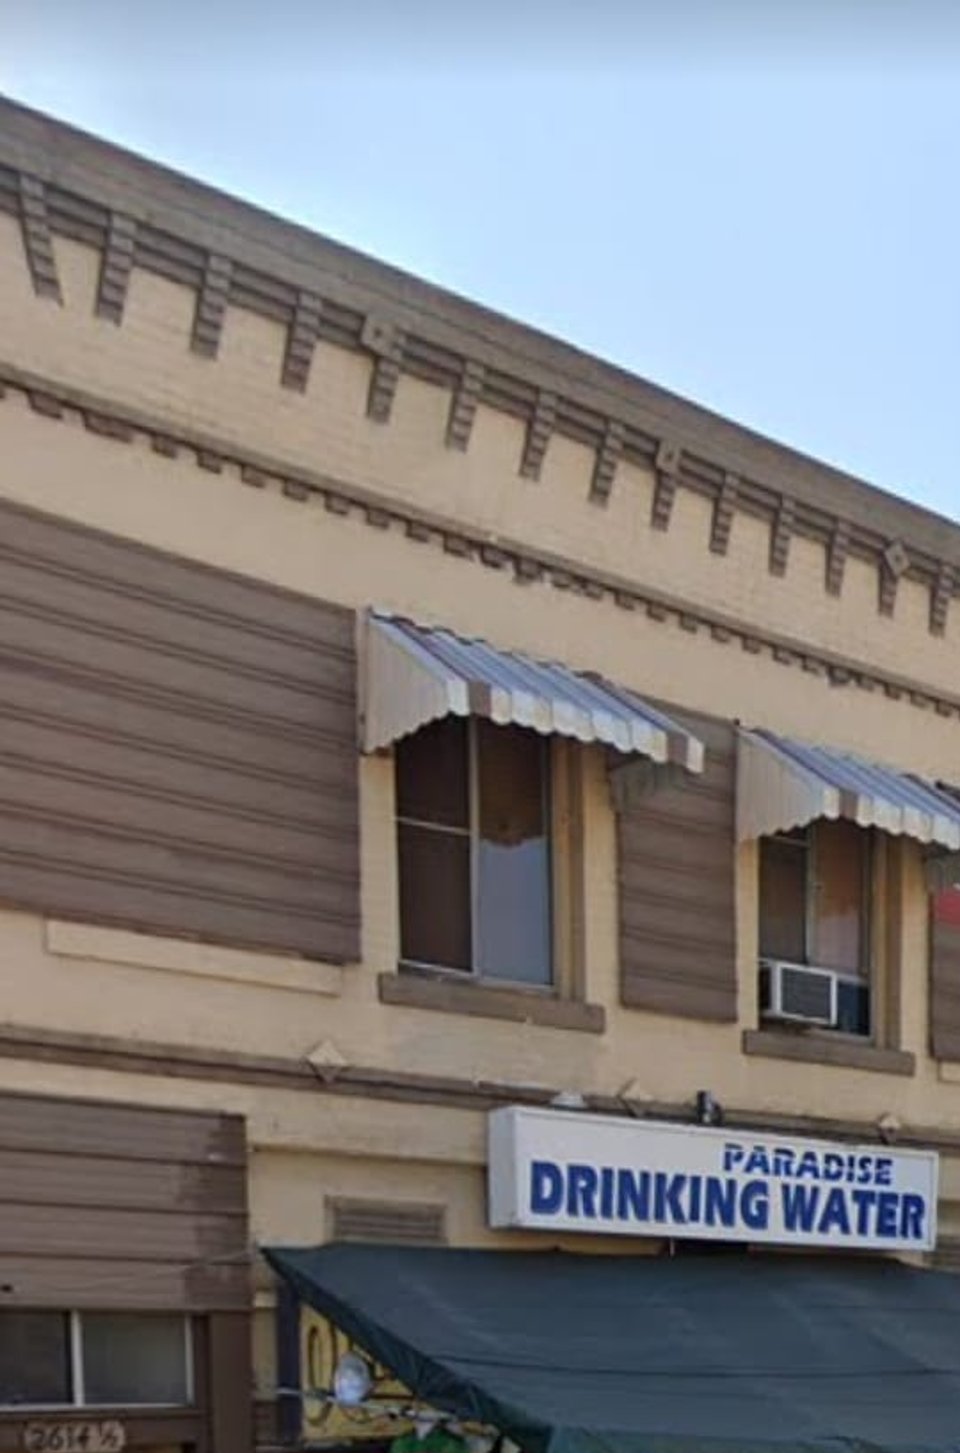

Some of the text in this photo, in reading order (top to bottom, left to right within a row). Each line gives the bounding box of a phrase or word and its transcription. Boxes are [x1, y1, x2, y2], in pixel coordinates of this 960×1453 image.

[723, 1142, 893, 1185] PARADISE
[530, 1161, 926, 1240] DRINKING WATER
[30, 1425, 90, 1451] 2614
